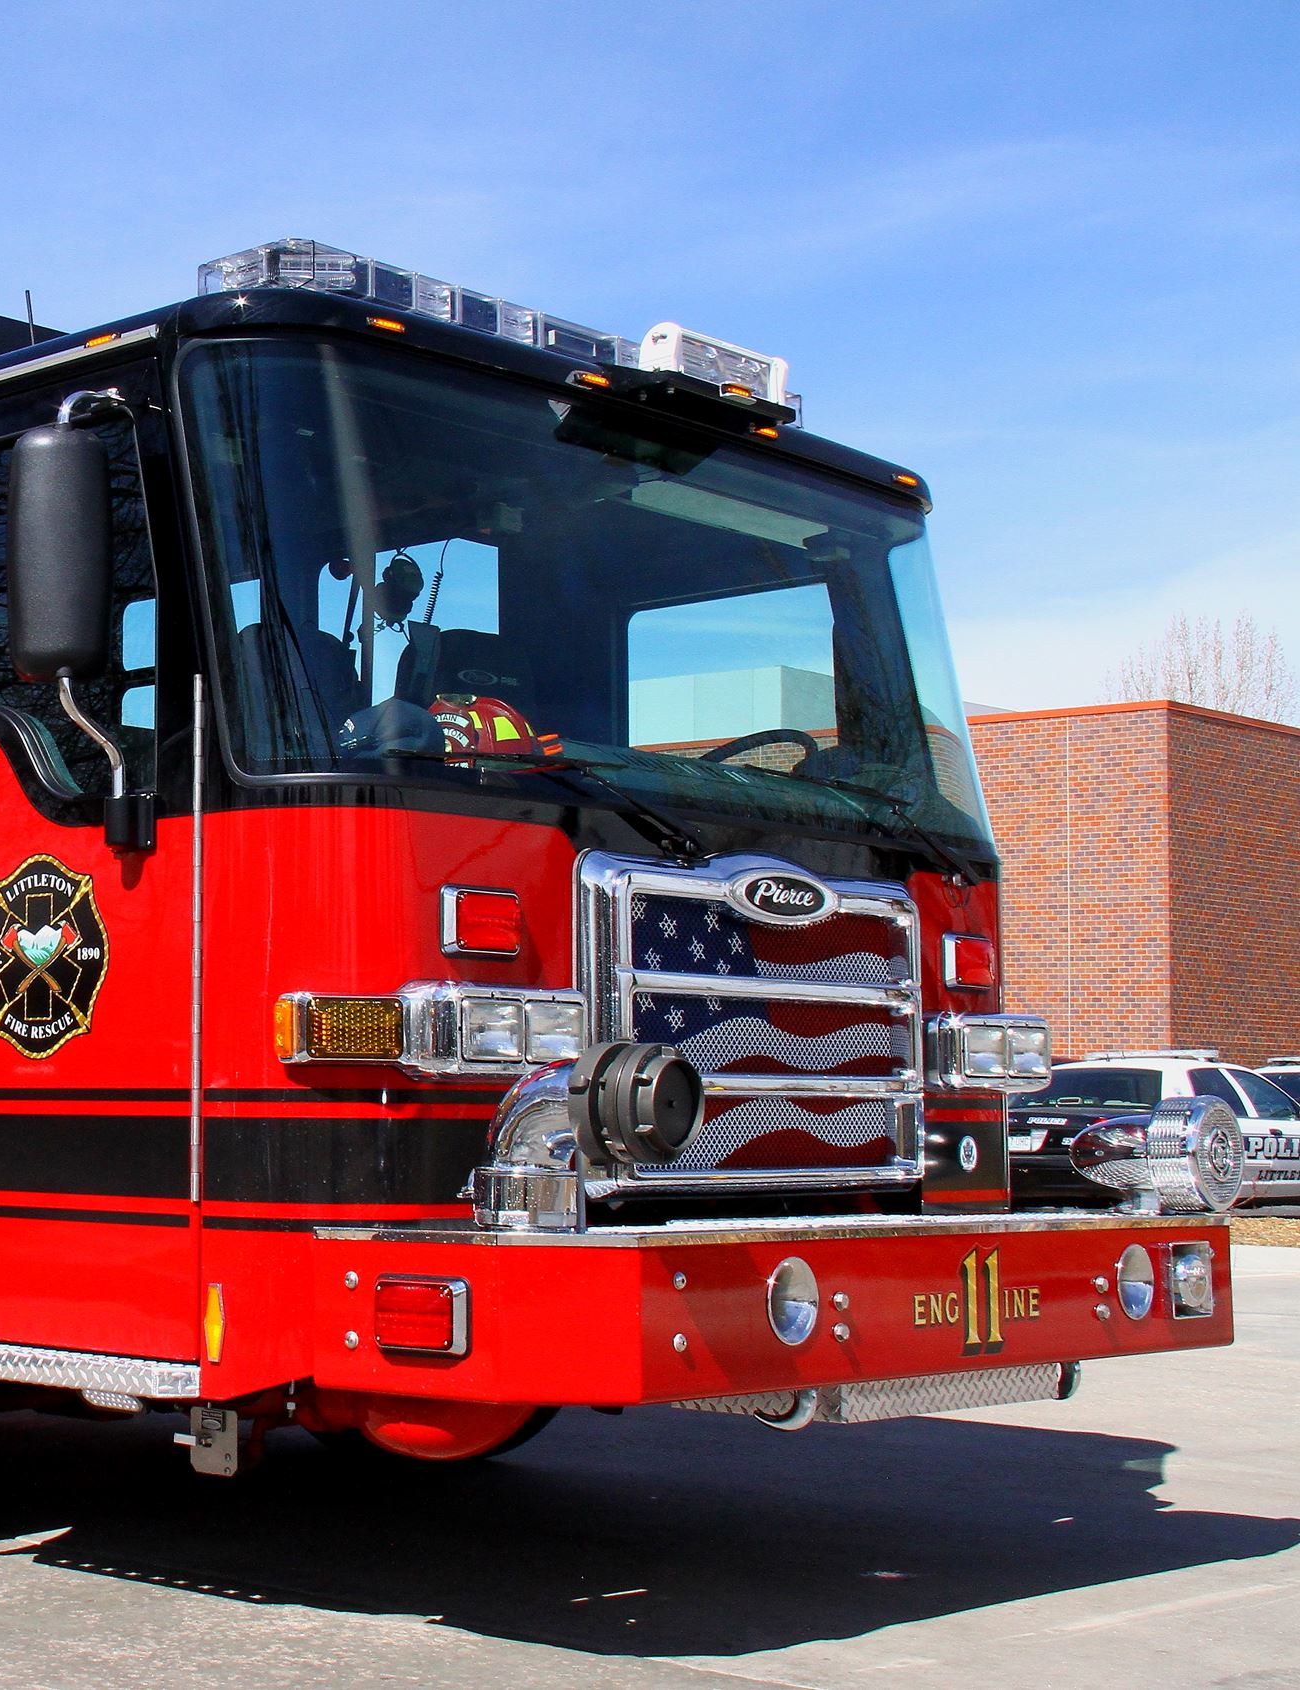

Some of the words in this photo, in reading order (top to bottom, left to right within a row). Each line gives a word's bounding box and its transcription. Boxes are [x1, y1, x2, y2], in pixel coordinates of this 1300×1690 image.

[5, 873, 74, 903] LITTLETON
[753, 879, 814, 907] Pierce
[76, 947, 101, 961] 1890
[4, 1012, 29, 1038] FIRE
[30, 1011, 74, 1040] RESCUE
[913, 1291, 959, 1326] ENG
[961, 1247, 1004, 1353] 11
[1003, 1286, 1040, 1320] INE
